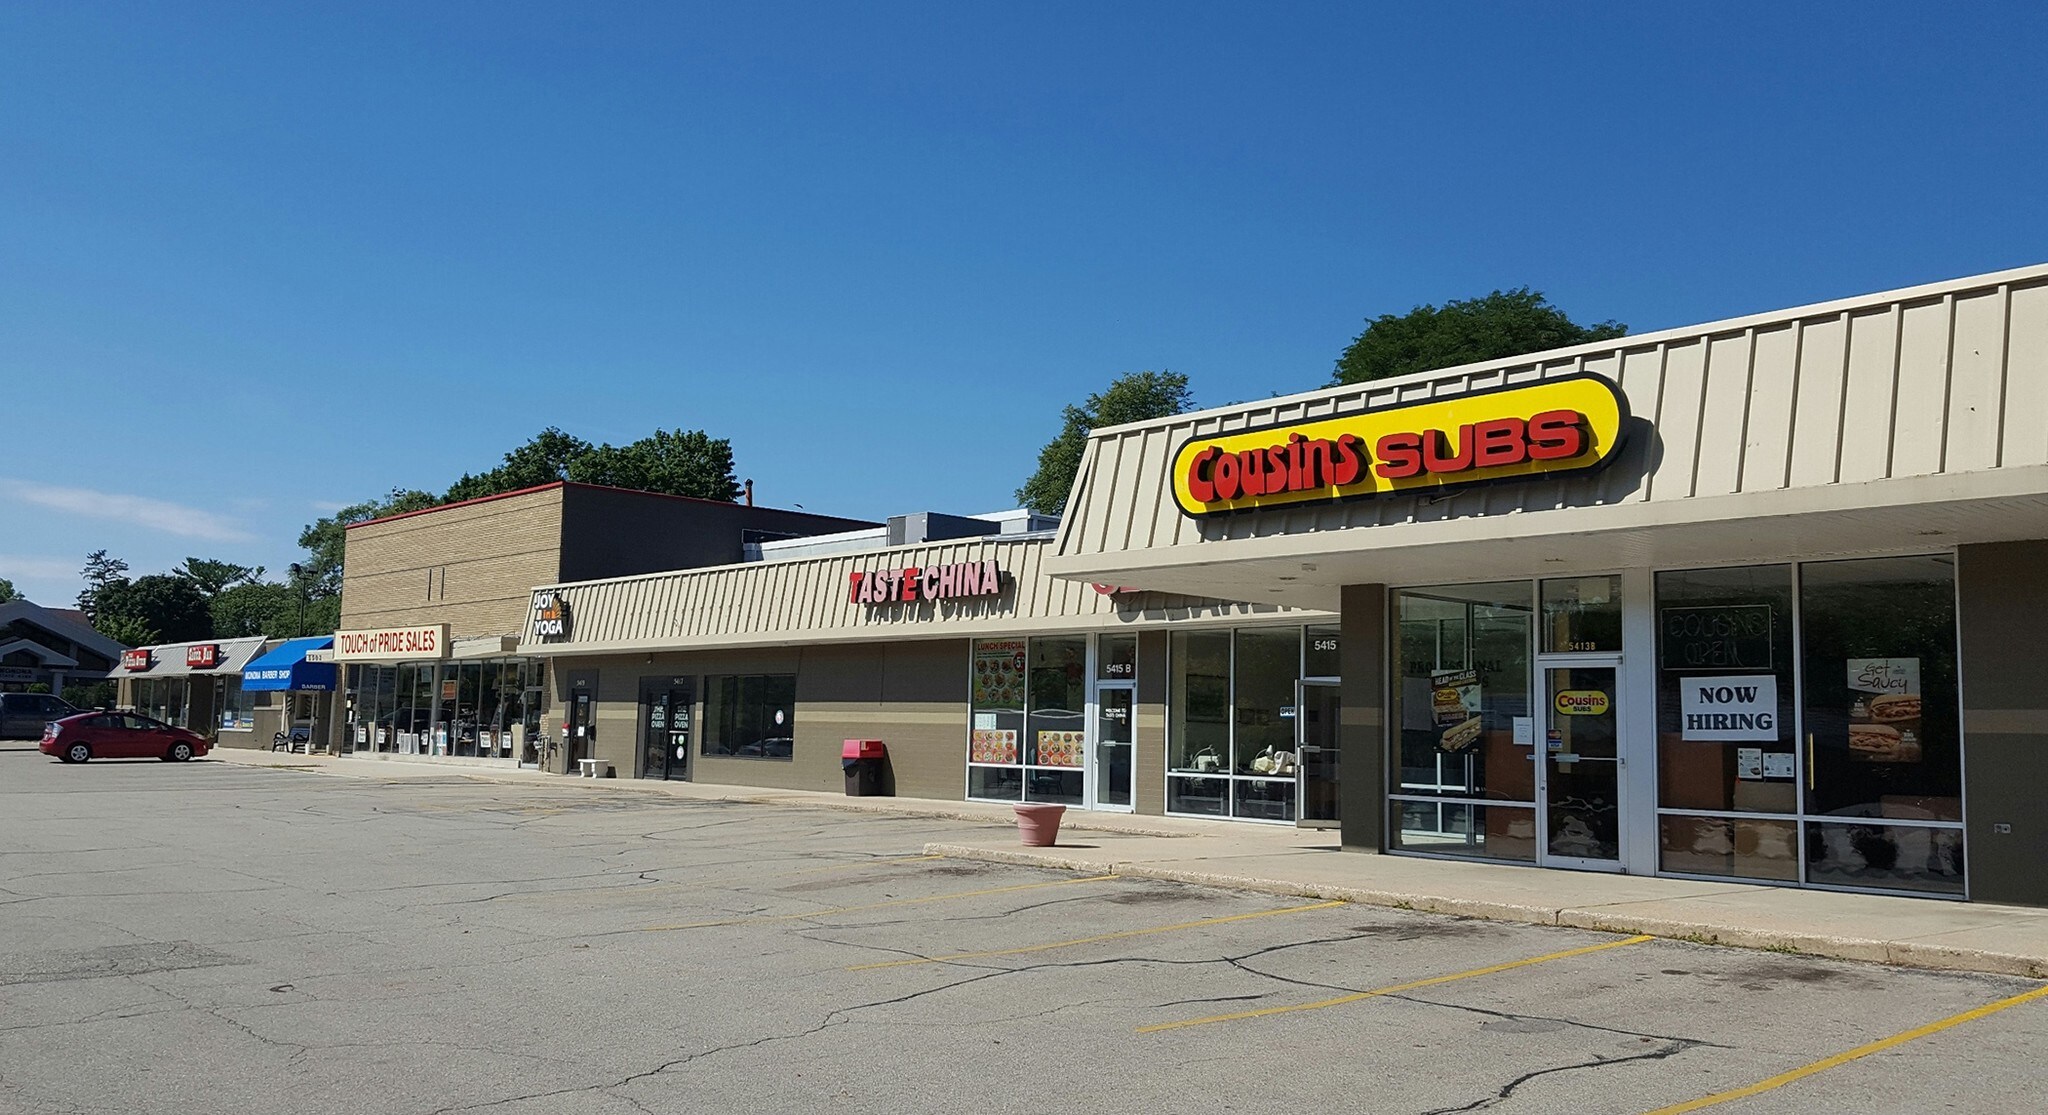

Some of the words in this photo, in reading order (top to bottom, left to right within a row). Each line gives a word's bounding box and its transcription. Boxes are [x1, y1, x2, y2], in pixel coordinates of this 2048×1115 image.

[1187, 432, 1361, 502] Cousins
[1375, 410, 1583, 479] SUBS
[850, 567, 919, 604] TASTE
[922, 559, 999, 602] CHINA
[535, 593, 555, 609] JOY
[535, 620, 563, 635] YOGA
[341, 633, 368, 654] TOUCH
[369, 633, 377, 653] of
[379, 631, 404, 652] PRIDE
[405, 630, 435, 652] SALES
[977, 642, 998, 651] LUNCH
[1000, 641, 1025, 650] SPECIAL
[1314, 640, 1337, 650] 5415
[1568, 642, 1596, 650] 5413B
[262, 670, 278, 679] BARBER
[279, 670, 290, 679] SHOP
[1106, 664, 1123, 673] 5415
[1125, 664, 1131, 673] B
[1459, 670, 1477, 680] CLASS
[1865, 659, 1891, 677] Get
[1857, 673, 1908, 694] Saucy
[1558, 695, 1605, 708] Cousins
[1698, 686, 1758, 704] NOW
[651, 720, 665, 728] OVEN
[1686, 712, 1773, 730] HIRING
